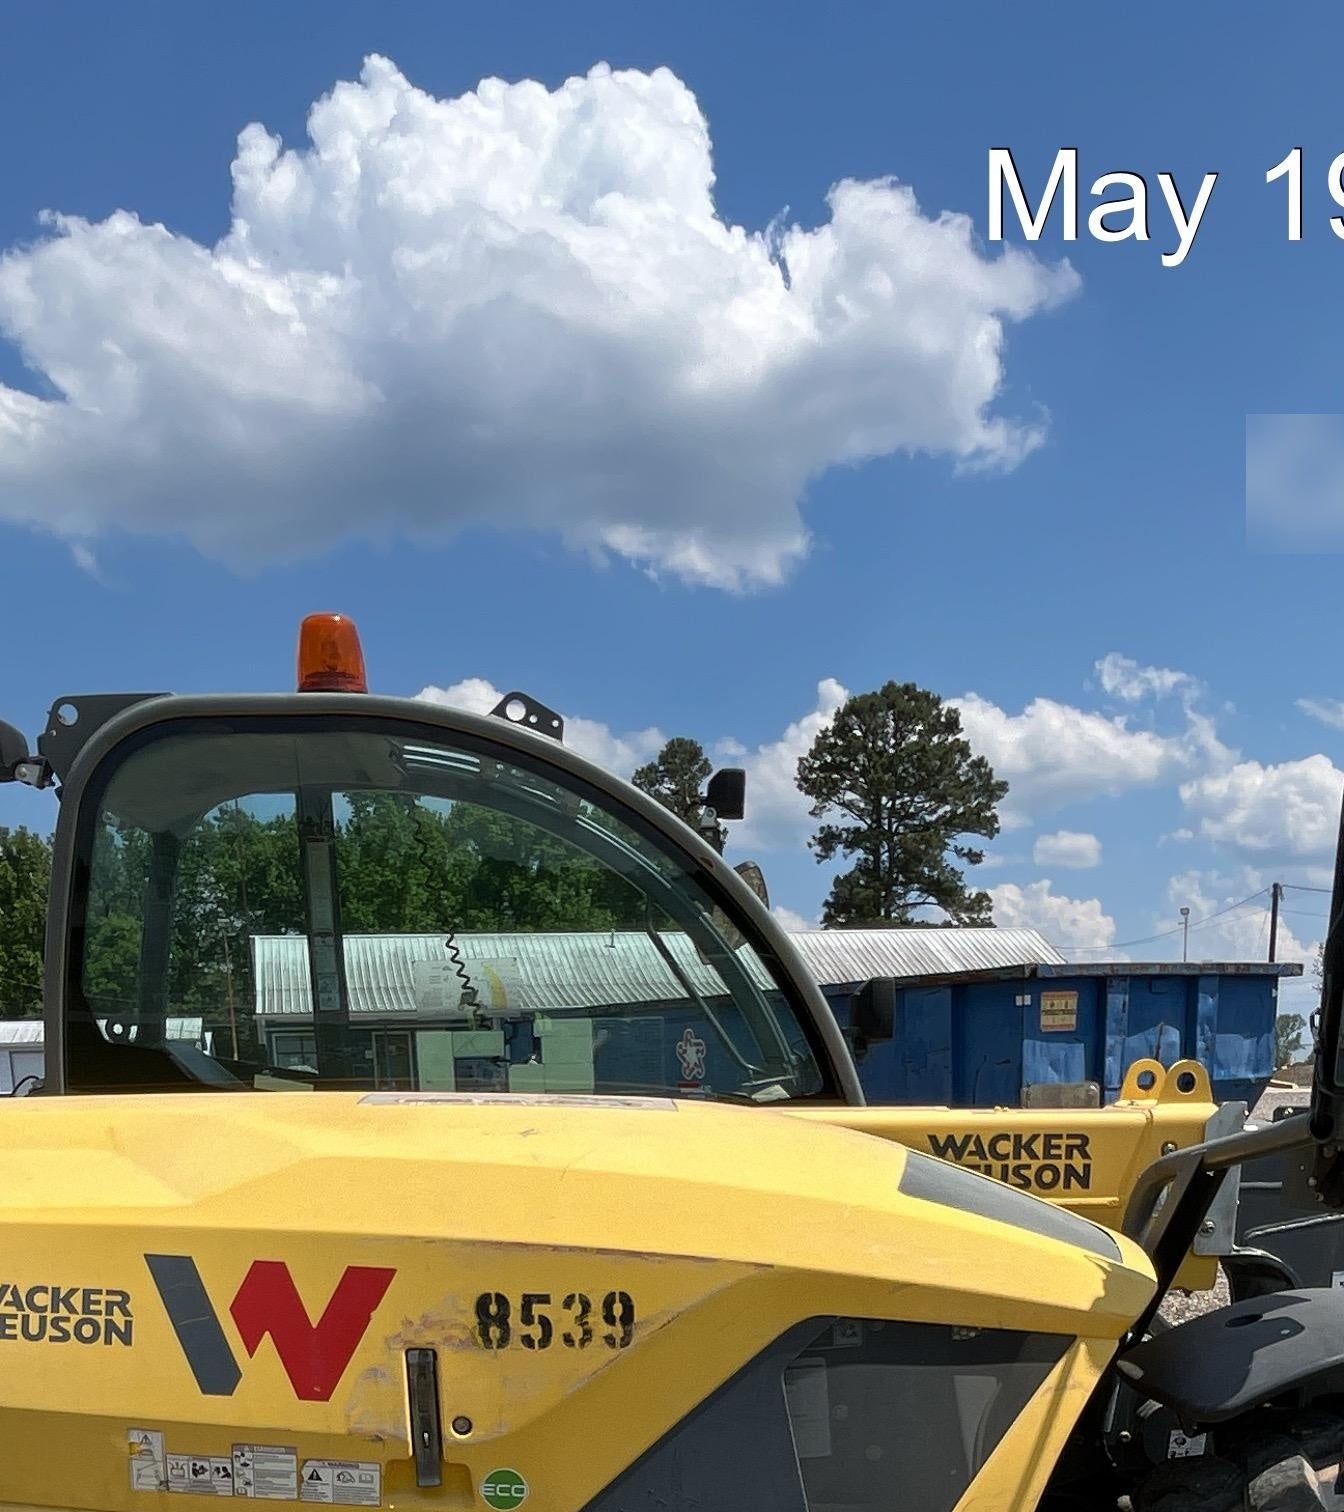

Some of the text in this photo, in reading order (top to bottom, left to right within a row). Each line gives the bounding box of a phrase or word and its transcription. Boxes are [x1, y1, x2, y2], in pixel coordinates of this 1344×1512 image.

[927, 1132, 1093, 1162] WACKER
[475, 1291, 636, 1350] 8539
[481, 1483, 528, 1497] ECO
